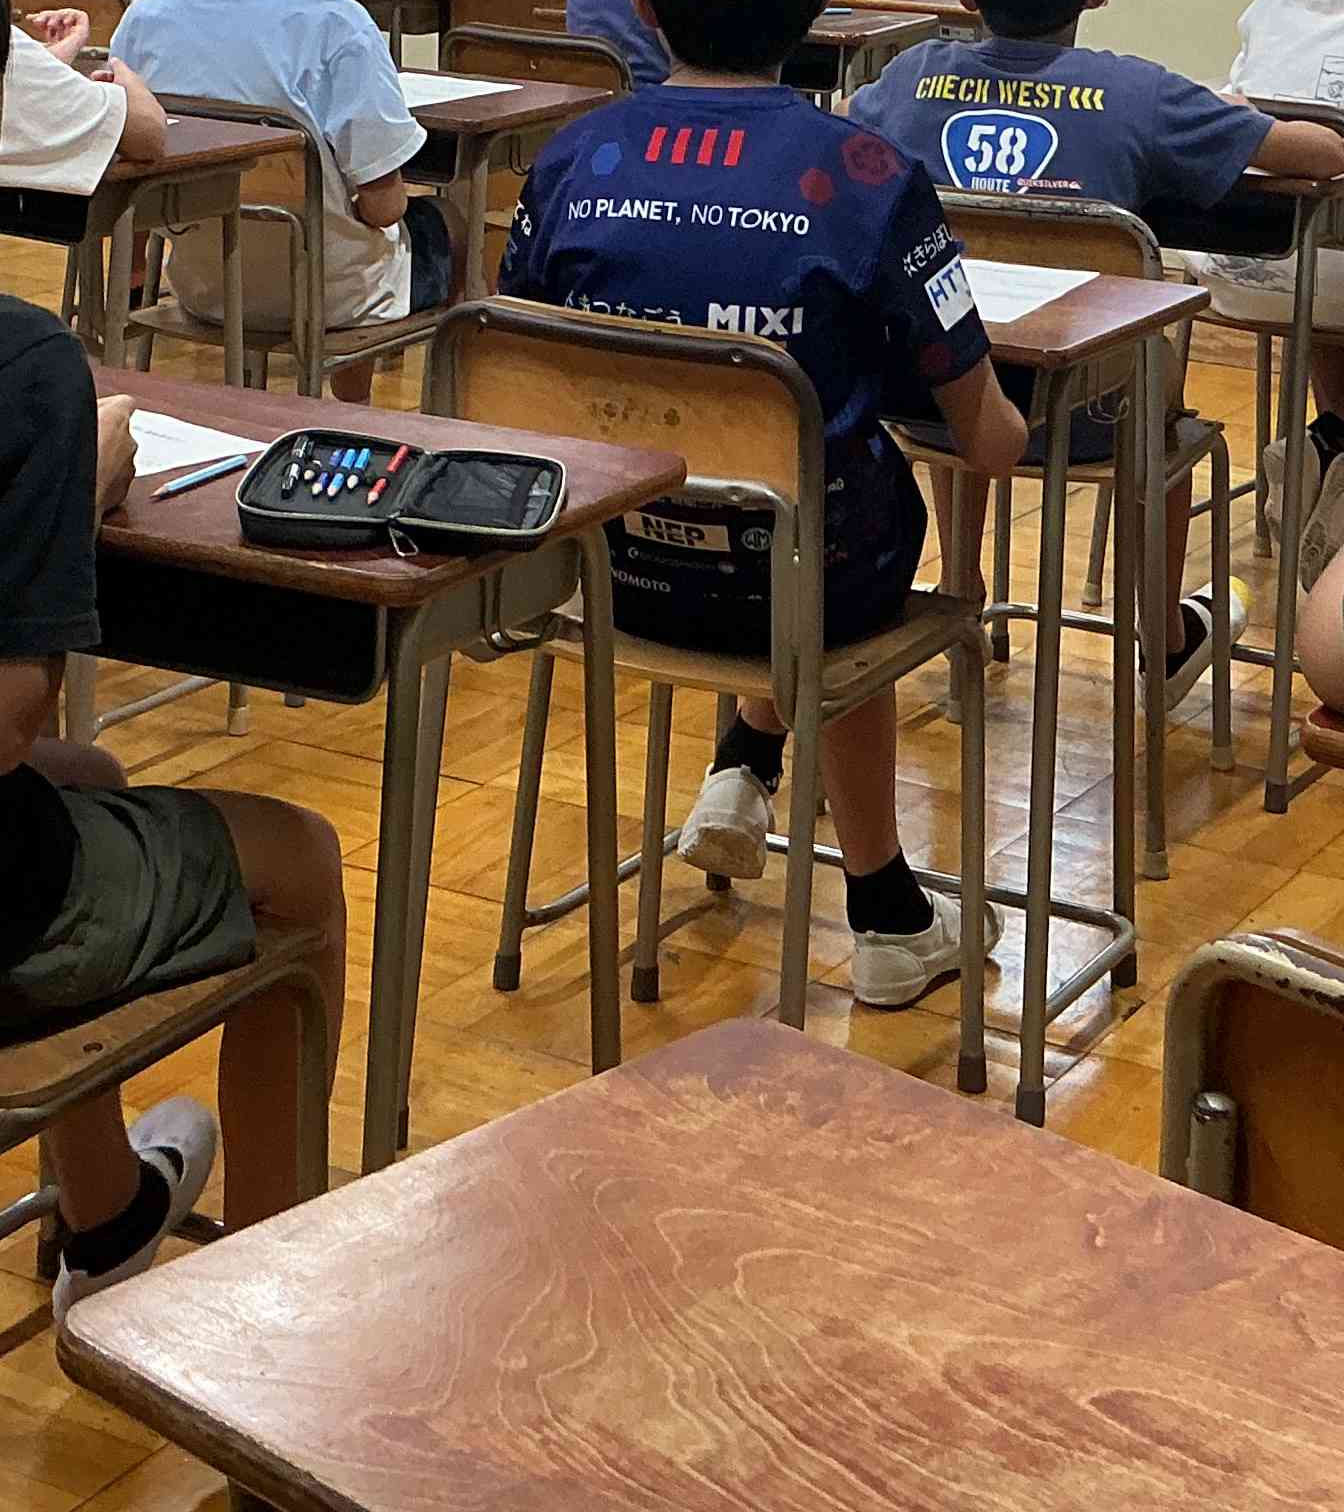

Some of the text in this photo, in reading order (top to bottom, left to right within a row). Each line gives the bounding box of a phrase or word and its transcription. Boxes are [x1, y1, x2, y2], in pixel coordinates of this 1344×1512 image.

[997, 78, 1065, 109] WEST
[963, 124, 1028, 176] 58
[568, 198, 810, 236] NO PLANET, NO TOKYO
[707, 302, 804, 337] MIXI
